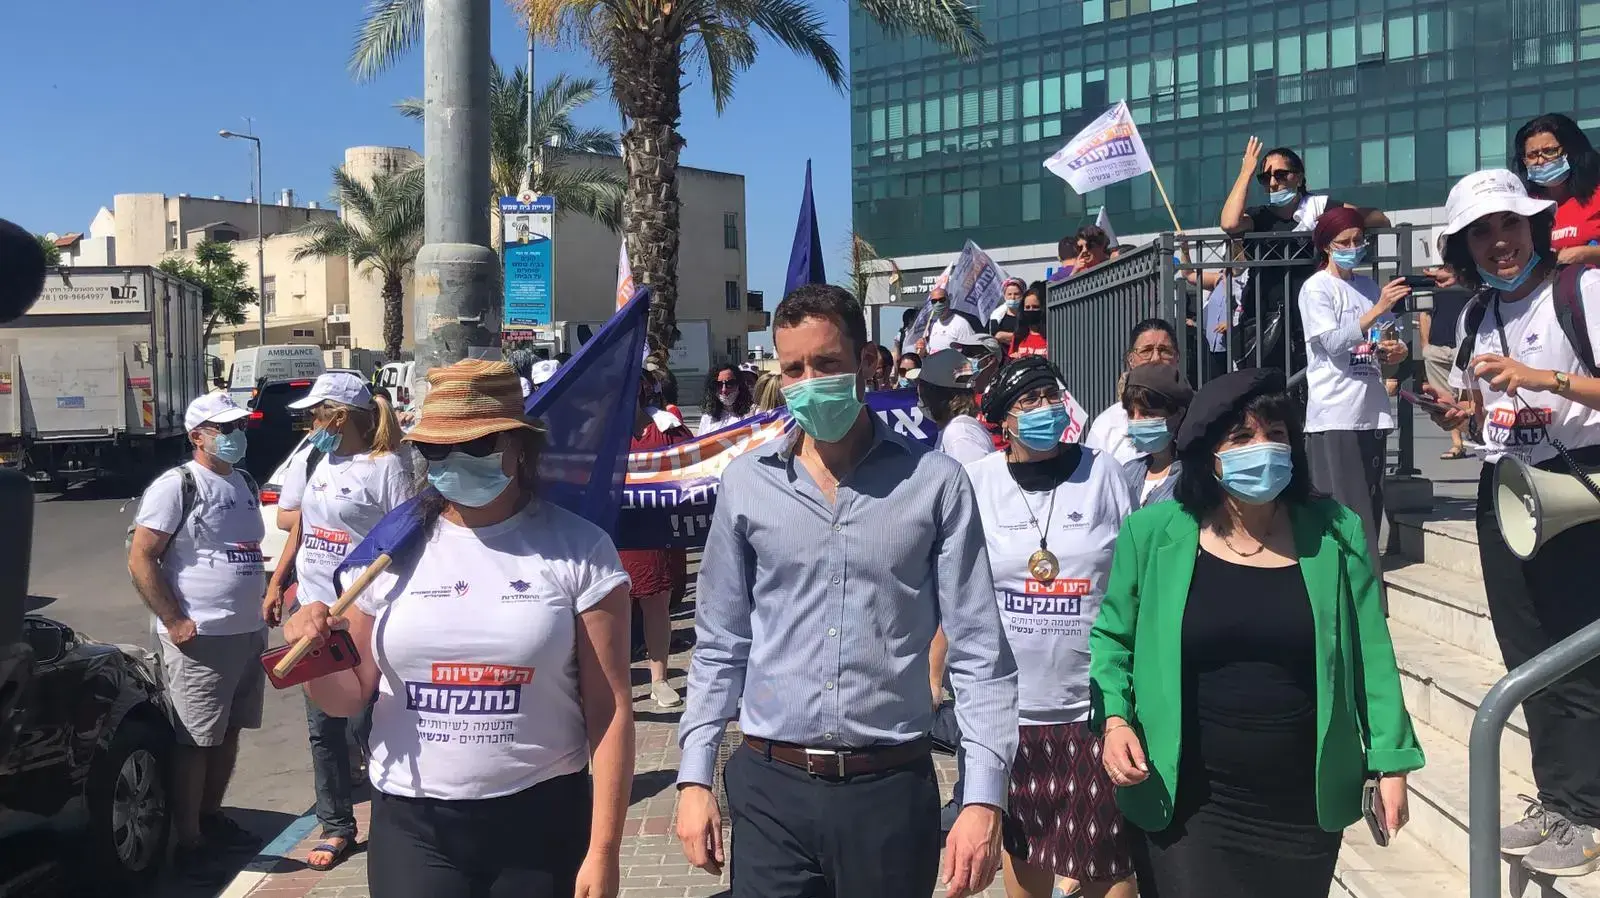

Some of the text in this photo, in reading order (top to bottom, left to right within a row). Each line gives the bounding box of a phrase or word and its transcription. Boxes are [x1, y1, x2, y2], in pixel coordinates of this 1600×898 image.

[268, 348, 313, 356] AMBULANCE
[1006, 595, 1078, 615] נחנקים!
[1010, 616, 1081, 627] הנשמה לשירותים
[1009, 625, 1034, 634] עכשיו!
[1041, 627, 1083, 637] החברתיים
[436, 666, 530, 683] העו"סיות
[407, 684, 516, 715] נחנקות!
[419, 718, 514, 732] הנשמה לשירותים
[459, 732, 515, 745] החברתיים
